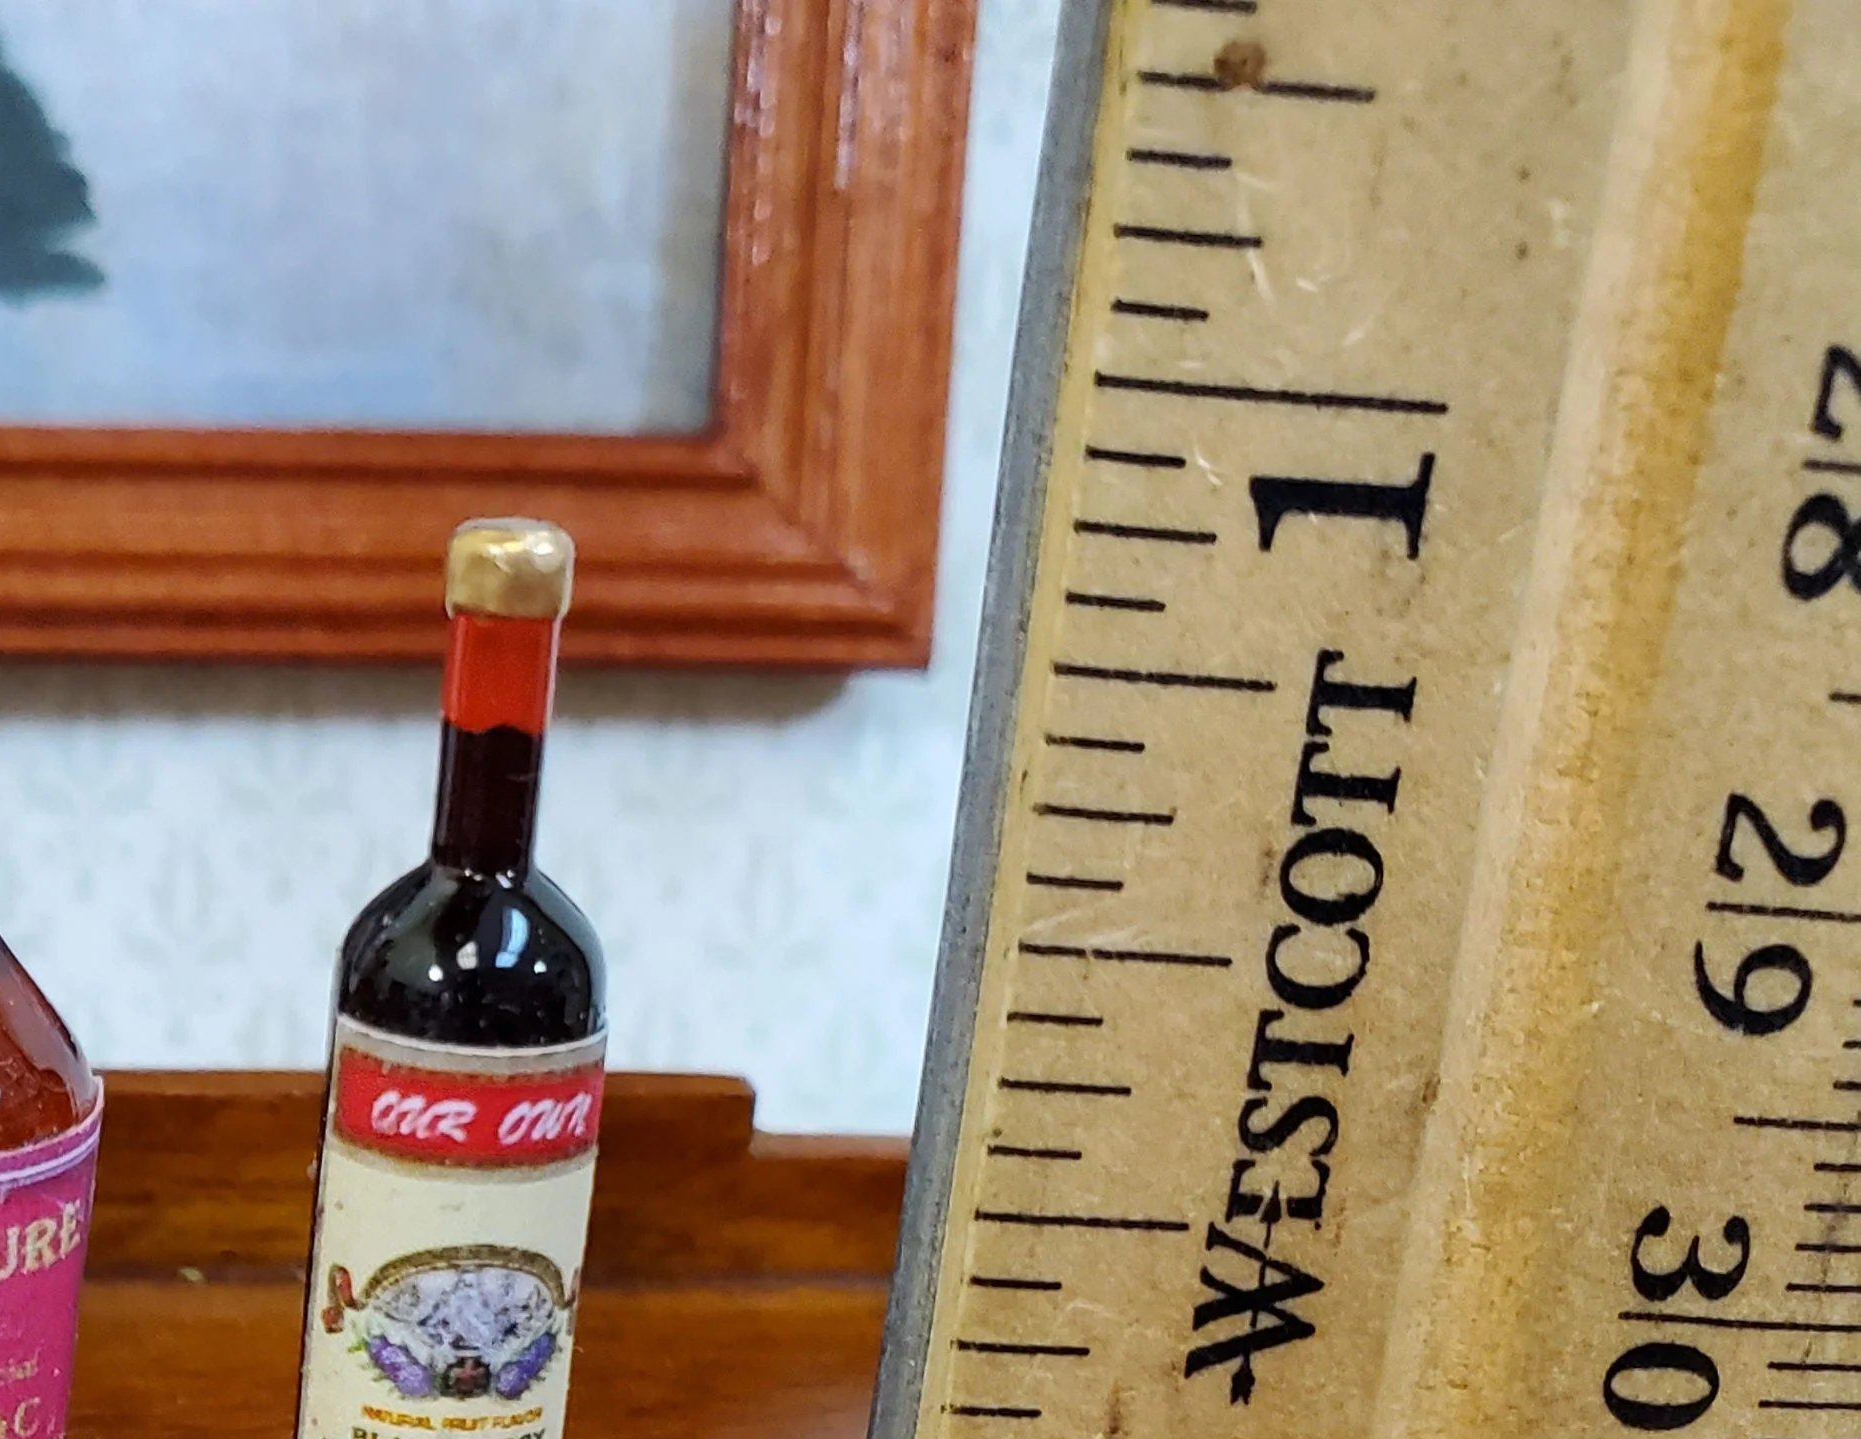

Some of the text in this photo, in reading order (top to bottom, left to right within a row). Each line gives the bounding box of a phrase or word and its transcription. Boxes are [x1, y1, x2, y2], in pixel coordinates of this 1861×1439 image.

[1249, 452, 1435, 560] 1
[1184, 649, 1417, 1385] WESTCOTT
[1694, 792, 1846, 1036] 29
[371, 1090, 478, 1143] OUR
[1603, 1206, 1750, 1431] 30
